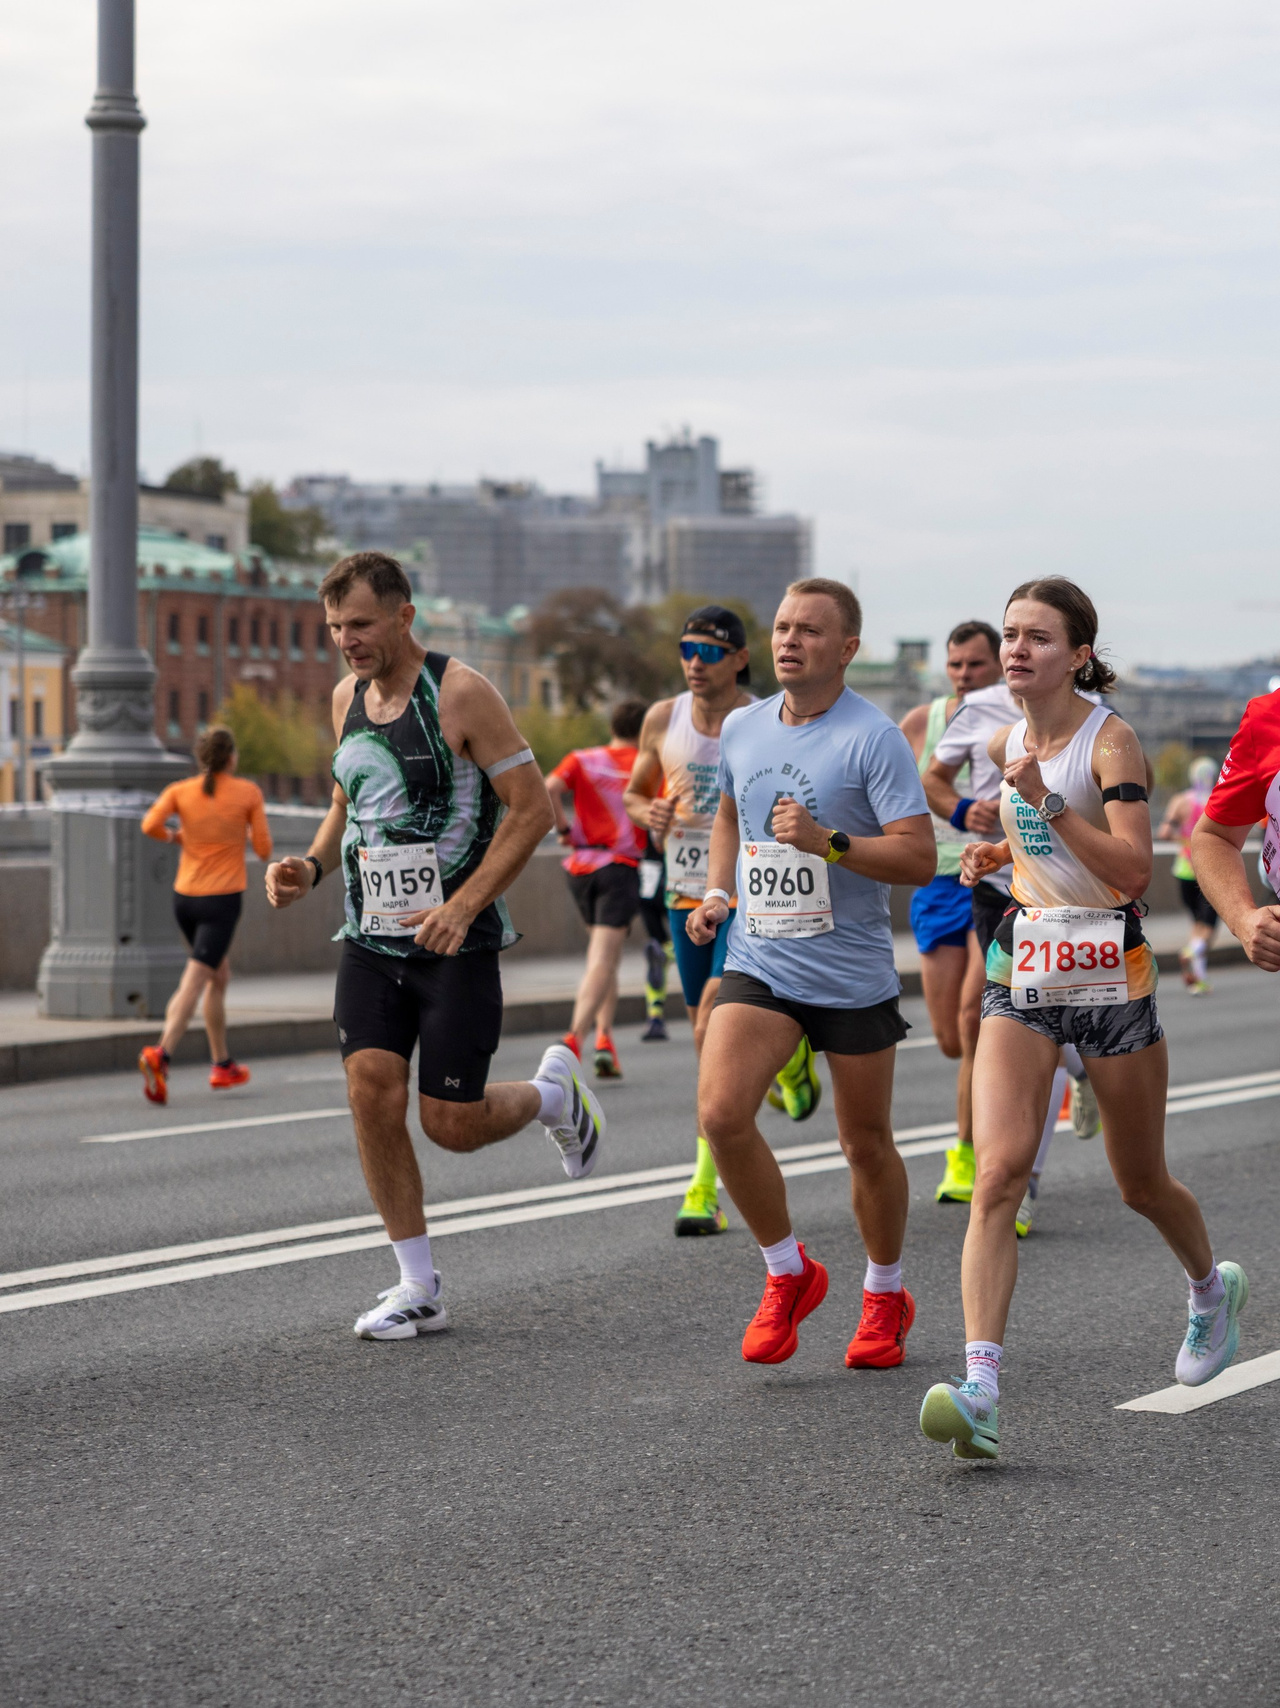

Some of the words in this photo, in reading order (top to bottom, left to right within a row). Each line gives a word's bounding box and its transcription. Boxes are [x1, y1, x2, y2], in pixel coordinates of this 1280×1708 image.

[740, 767, 773, 803] режим
[1016, 819, 1049, 830] Ultra
[1020, 831, 1051, 843] Trail
[1023, 844, 1053, 856] 100
[363, 866, 436, 897] 19159
[749, 867, 815, 897] 8960
[382, 898, 410, 909] АНДРЕЙ
[765, 900, 797, 908] МИХАИЛ
[1017, 940, 1120, 972] 21838
[1026, 988, 1039, 1004] B
